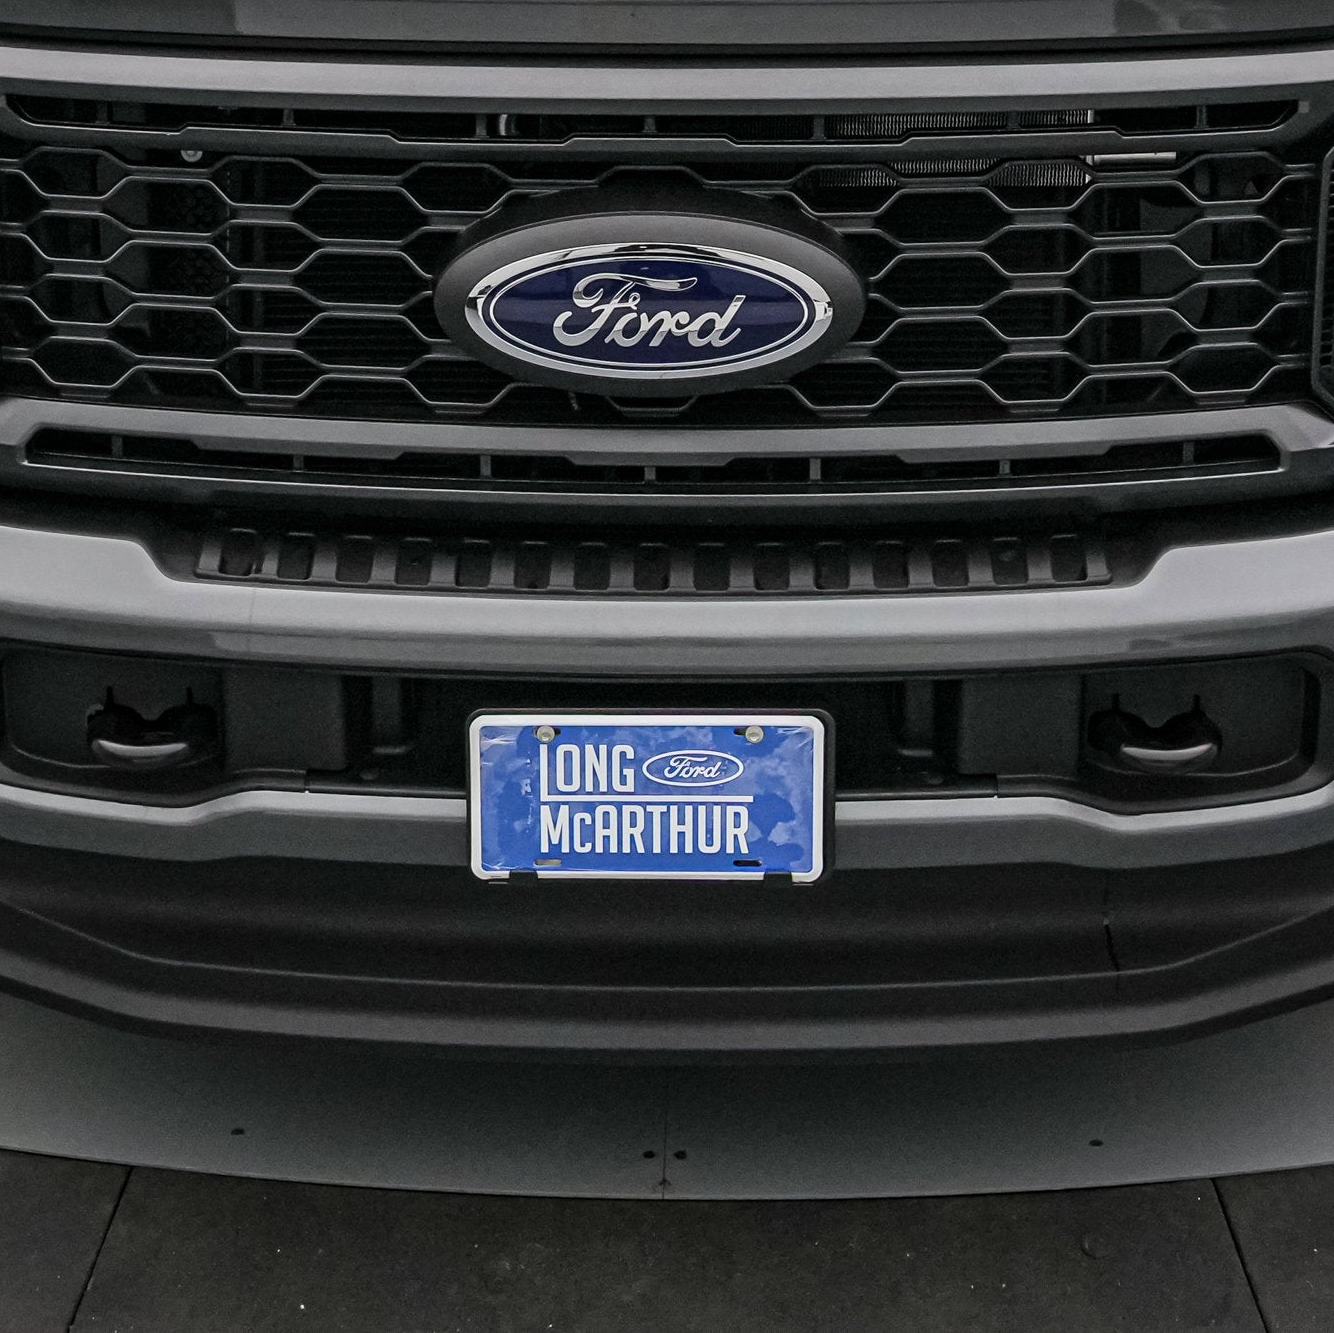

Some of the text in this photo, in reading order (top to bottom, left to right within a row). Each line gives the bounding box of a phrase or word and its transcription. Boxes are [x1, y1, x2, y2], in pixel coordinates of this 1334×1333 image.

[552, 272, 747, 348] Ford
[539, 743, 635, 802] LONG
[663, 755, 722, 779] Ford
[540, 804, 750, 854] McARTHUR
